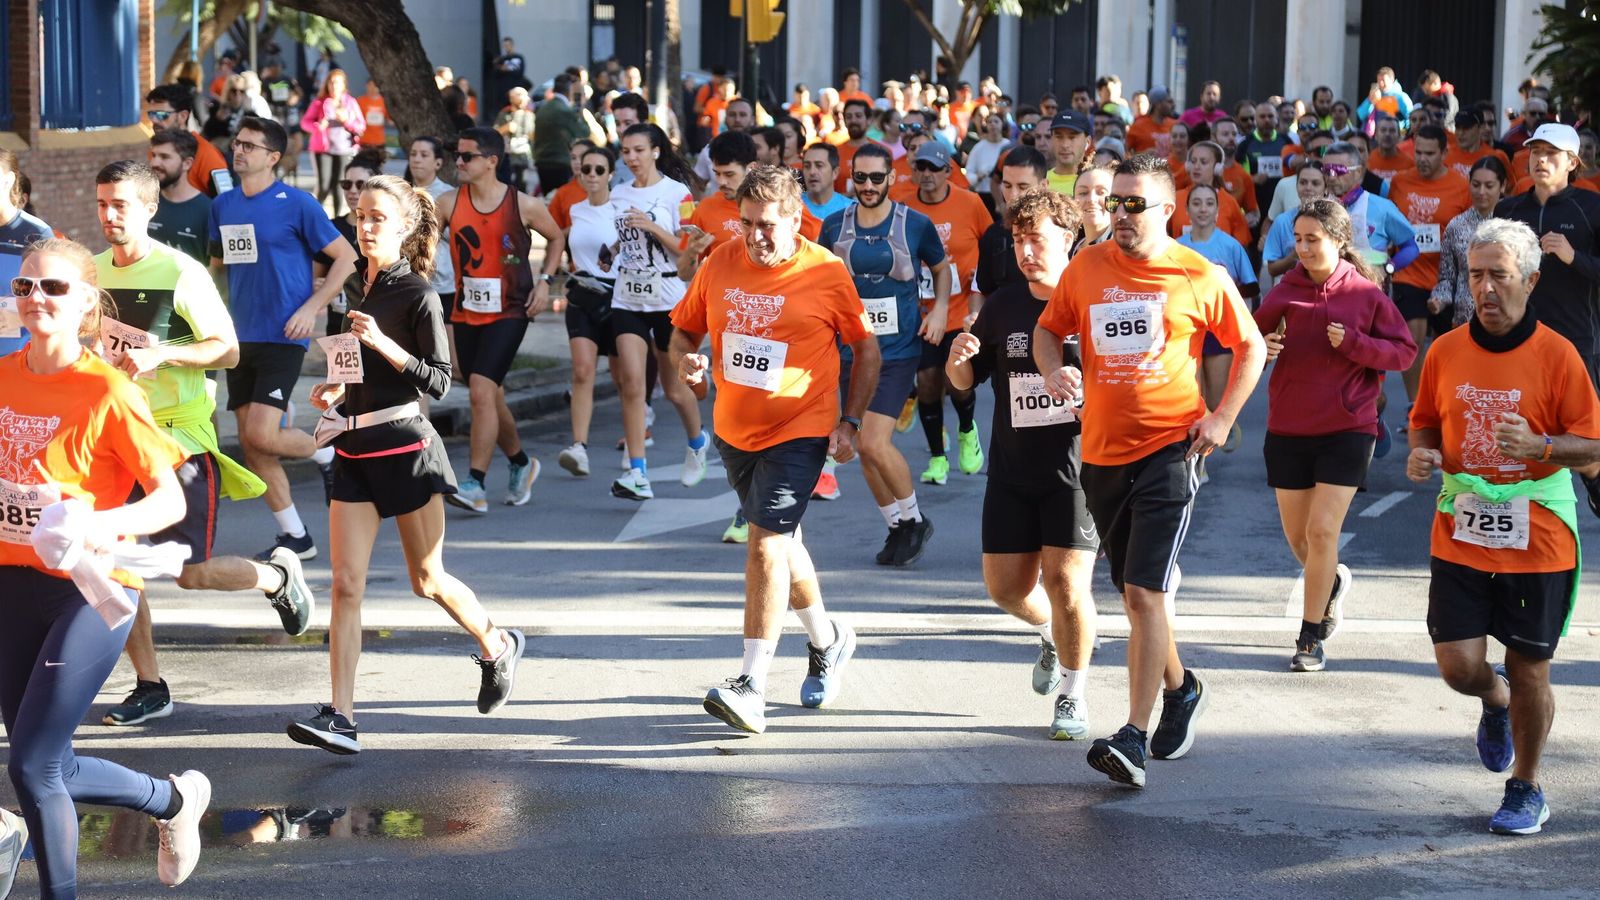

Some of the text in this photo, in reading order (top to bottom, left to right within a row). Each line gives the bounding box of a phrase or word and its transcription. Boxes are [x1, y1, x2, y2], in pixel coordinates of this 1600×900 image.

[228, 237, 252, 251] 808
[625, 281, 653, 294] 164
[1104, 319, 1148, 338] 996
[334, 351, 360, 368] 425
[732, 352, 770, 372] 998
[1462, 510, 1513, 532] 725
